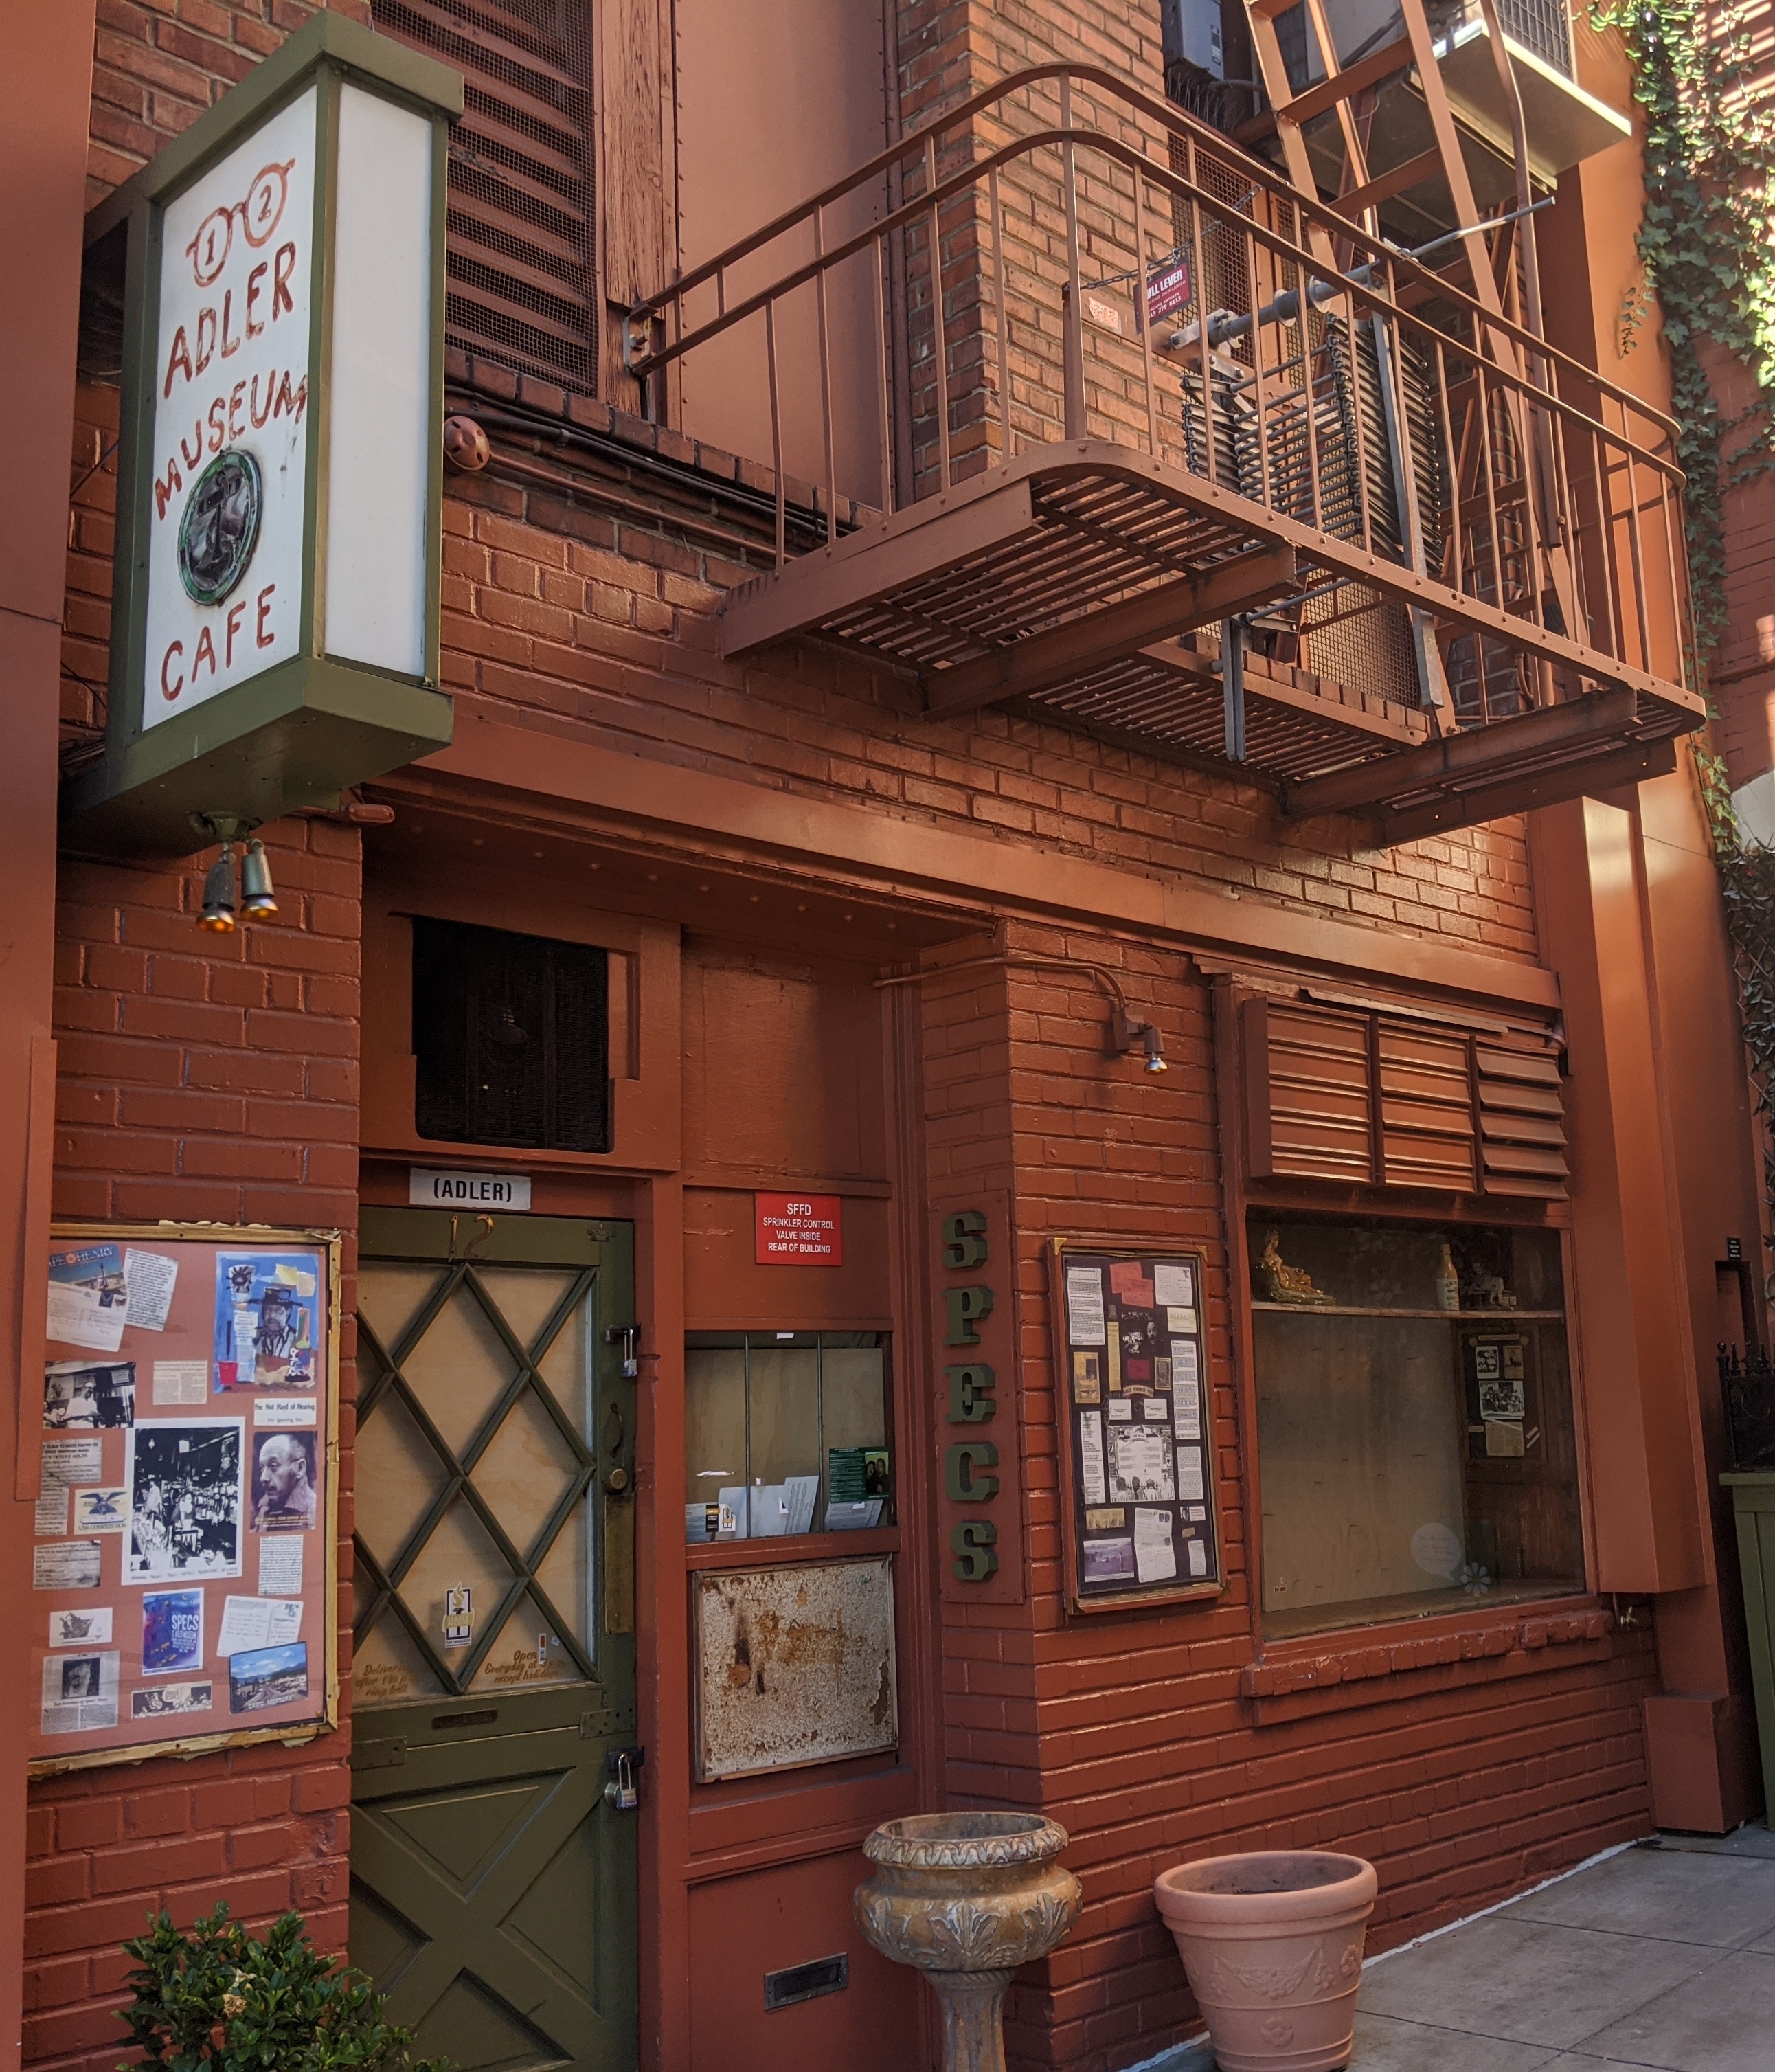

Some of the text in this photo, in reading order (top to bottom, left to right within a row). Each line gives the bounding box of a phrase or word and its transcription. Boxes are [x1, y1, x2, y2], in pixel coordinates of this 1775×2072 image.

[258, 184, 272, 223] 2
[1146, 269, 1183, 300] ULL LEVER
[165, 240, 297, 400] ADLER
[155, 369, 308, 521] MUSEUM
[161, 583, 275, 701] CAFE
[433, 1177, 512, 1203] (ADLER)
[787, 1203, 812, 1216] SFFD
[763, 1217, 835, 1230] SPRINKLER CONTROL
[776, 1230, 822, 1241] VALVE INSIDE
[77, 1246, 114, 1262] HENRY
[768, 1242, 831, 1254] REAR OF BUILDING
[941, 1211, 1001, 1582] SPECS
[297, 1403, 315, 1412] Hearing
[172, 1614, 199, 1630] SPECS
[513, 1650, 538, 1663] Open
[484, 1663, 526, 1674] Everyday
[528, 1660, 537, 1669] at
[494, 1673, 521, 1685] except
[389, 1683, 408, 1695] bell
